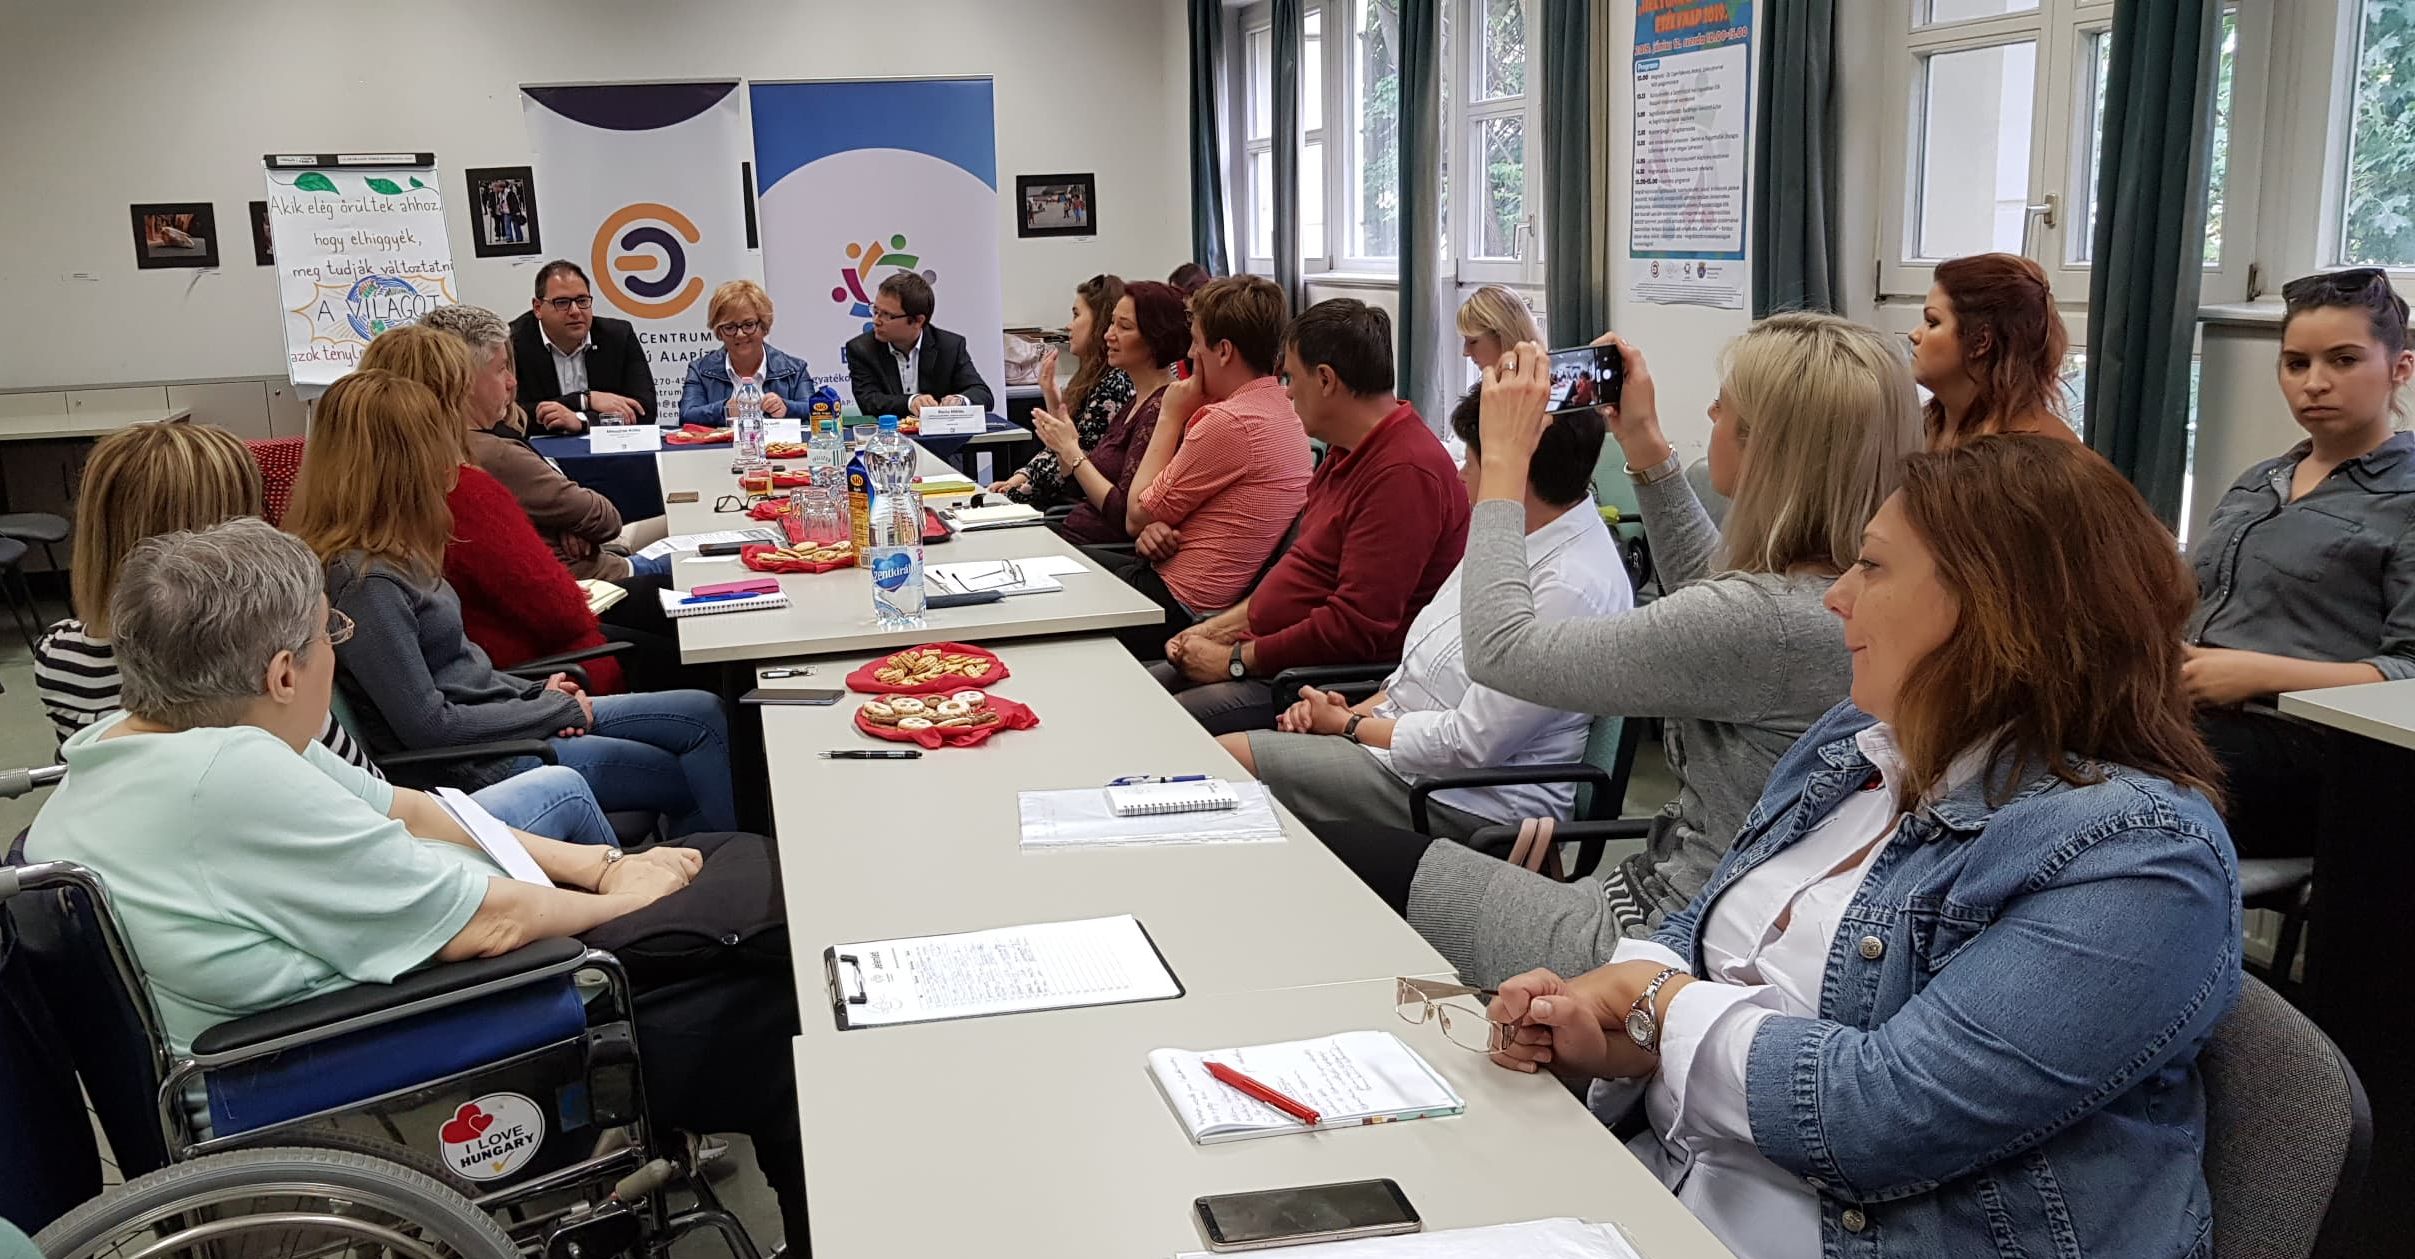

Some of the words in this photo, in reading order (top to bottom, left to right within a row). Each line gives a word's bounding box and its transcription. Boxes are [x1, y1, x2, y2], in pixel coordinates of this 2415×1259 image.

[270, 196, 304, 216] Akik
[308, 196, 333, 220] elég
[314, 232, 344, 252] hogy
[293, 266, 320, 281] meg
[327, 258, 375, 280] tudják
[318, 300, 335, 322] A
[291, 345, 320, 362] azok
[322, 344, 364, 367] tényl
[660, 348, 712, 362] ALAPÍ
[460, 1132, 534, 1168] HUNGARY
[465, 1143, 471, 1154] I
[478, 1124, 524, 1149] LOVE
